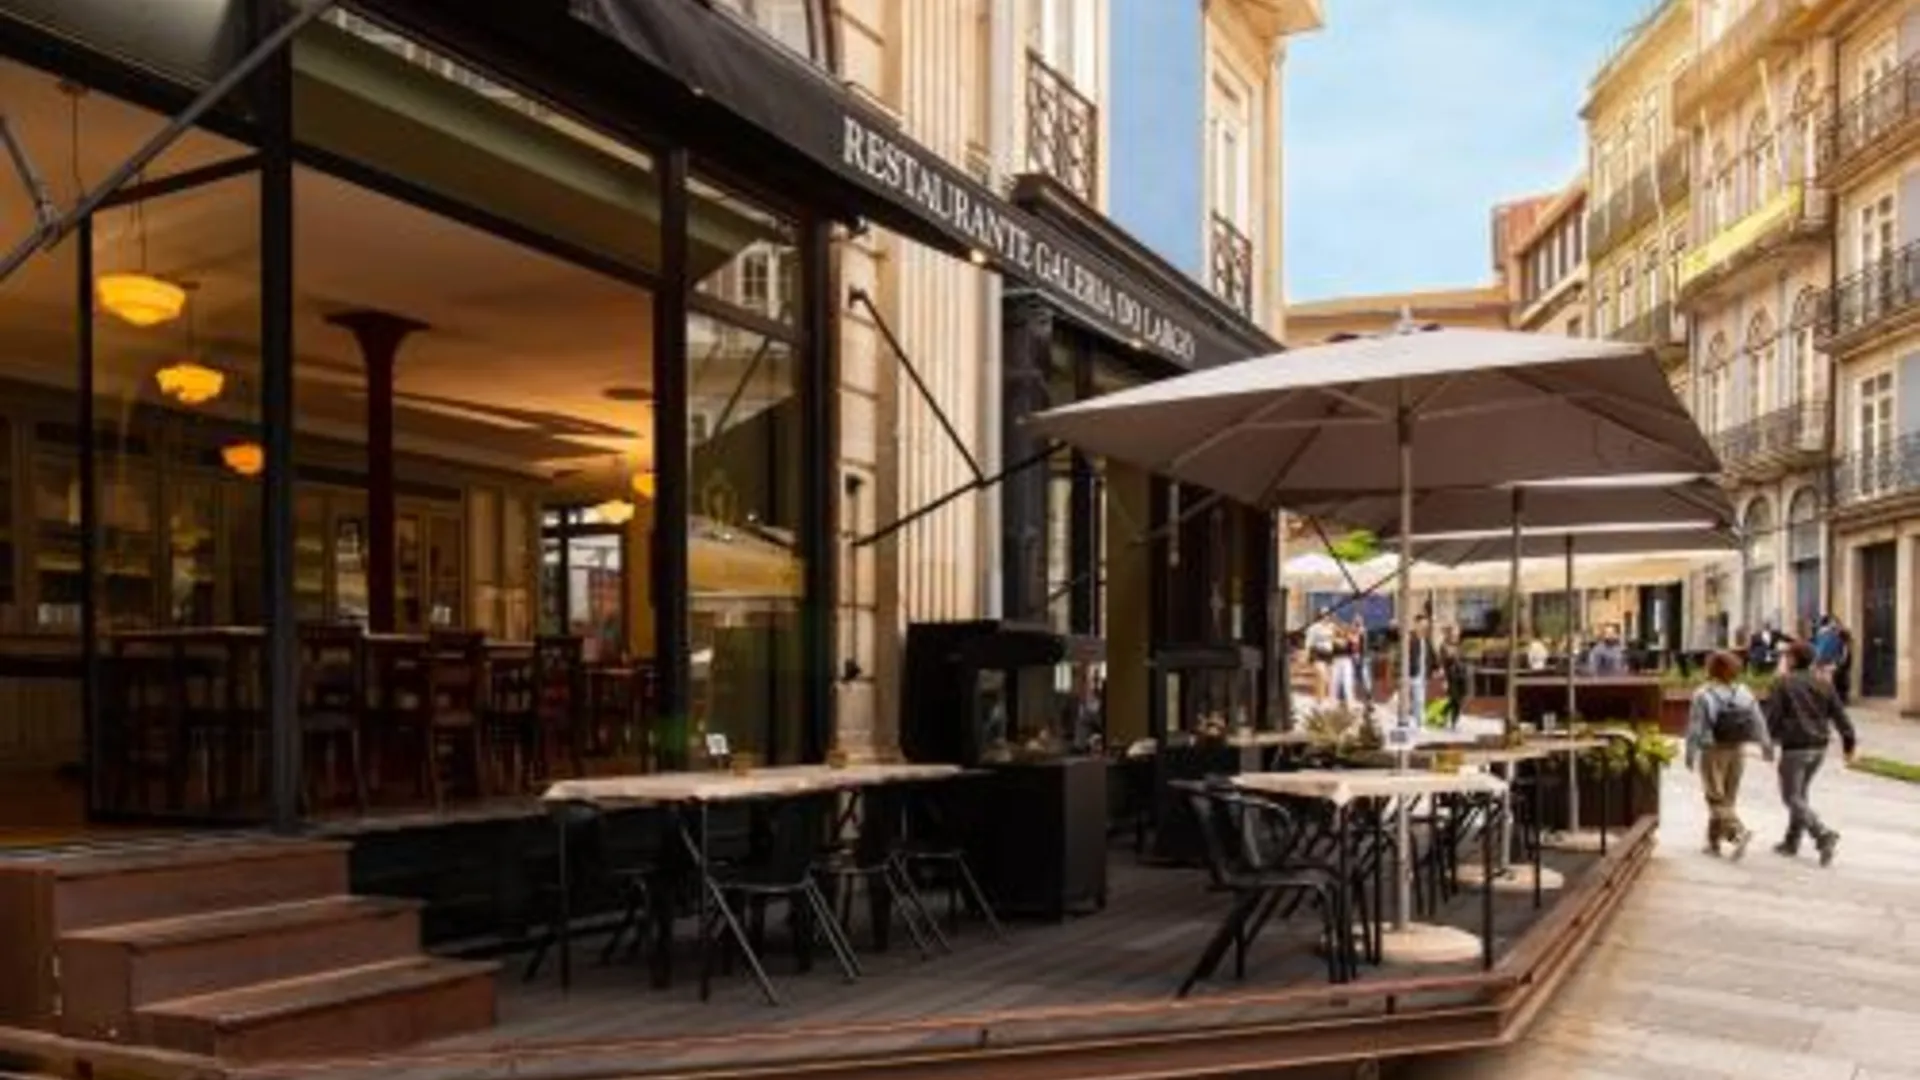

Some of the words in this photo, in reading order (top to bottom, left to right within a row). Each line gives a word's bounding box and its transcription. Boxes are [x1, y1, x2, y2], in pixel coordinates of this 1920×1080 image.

[843, 116, 1032, 270] RESTAURANTE
[1036, 242, 1115, 320] GALERIA
[1117, 292, 1141, 331] DO
[1144, 307, 1195, 361] LARGO
